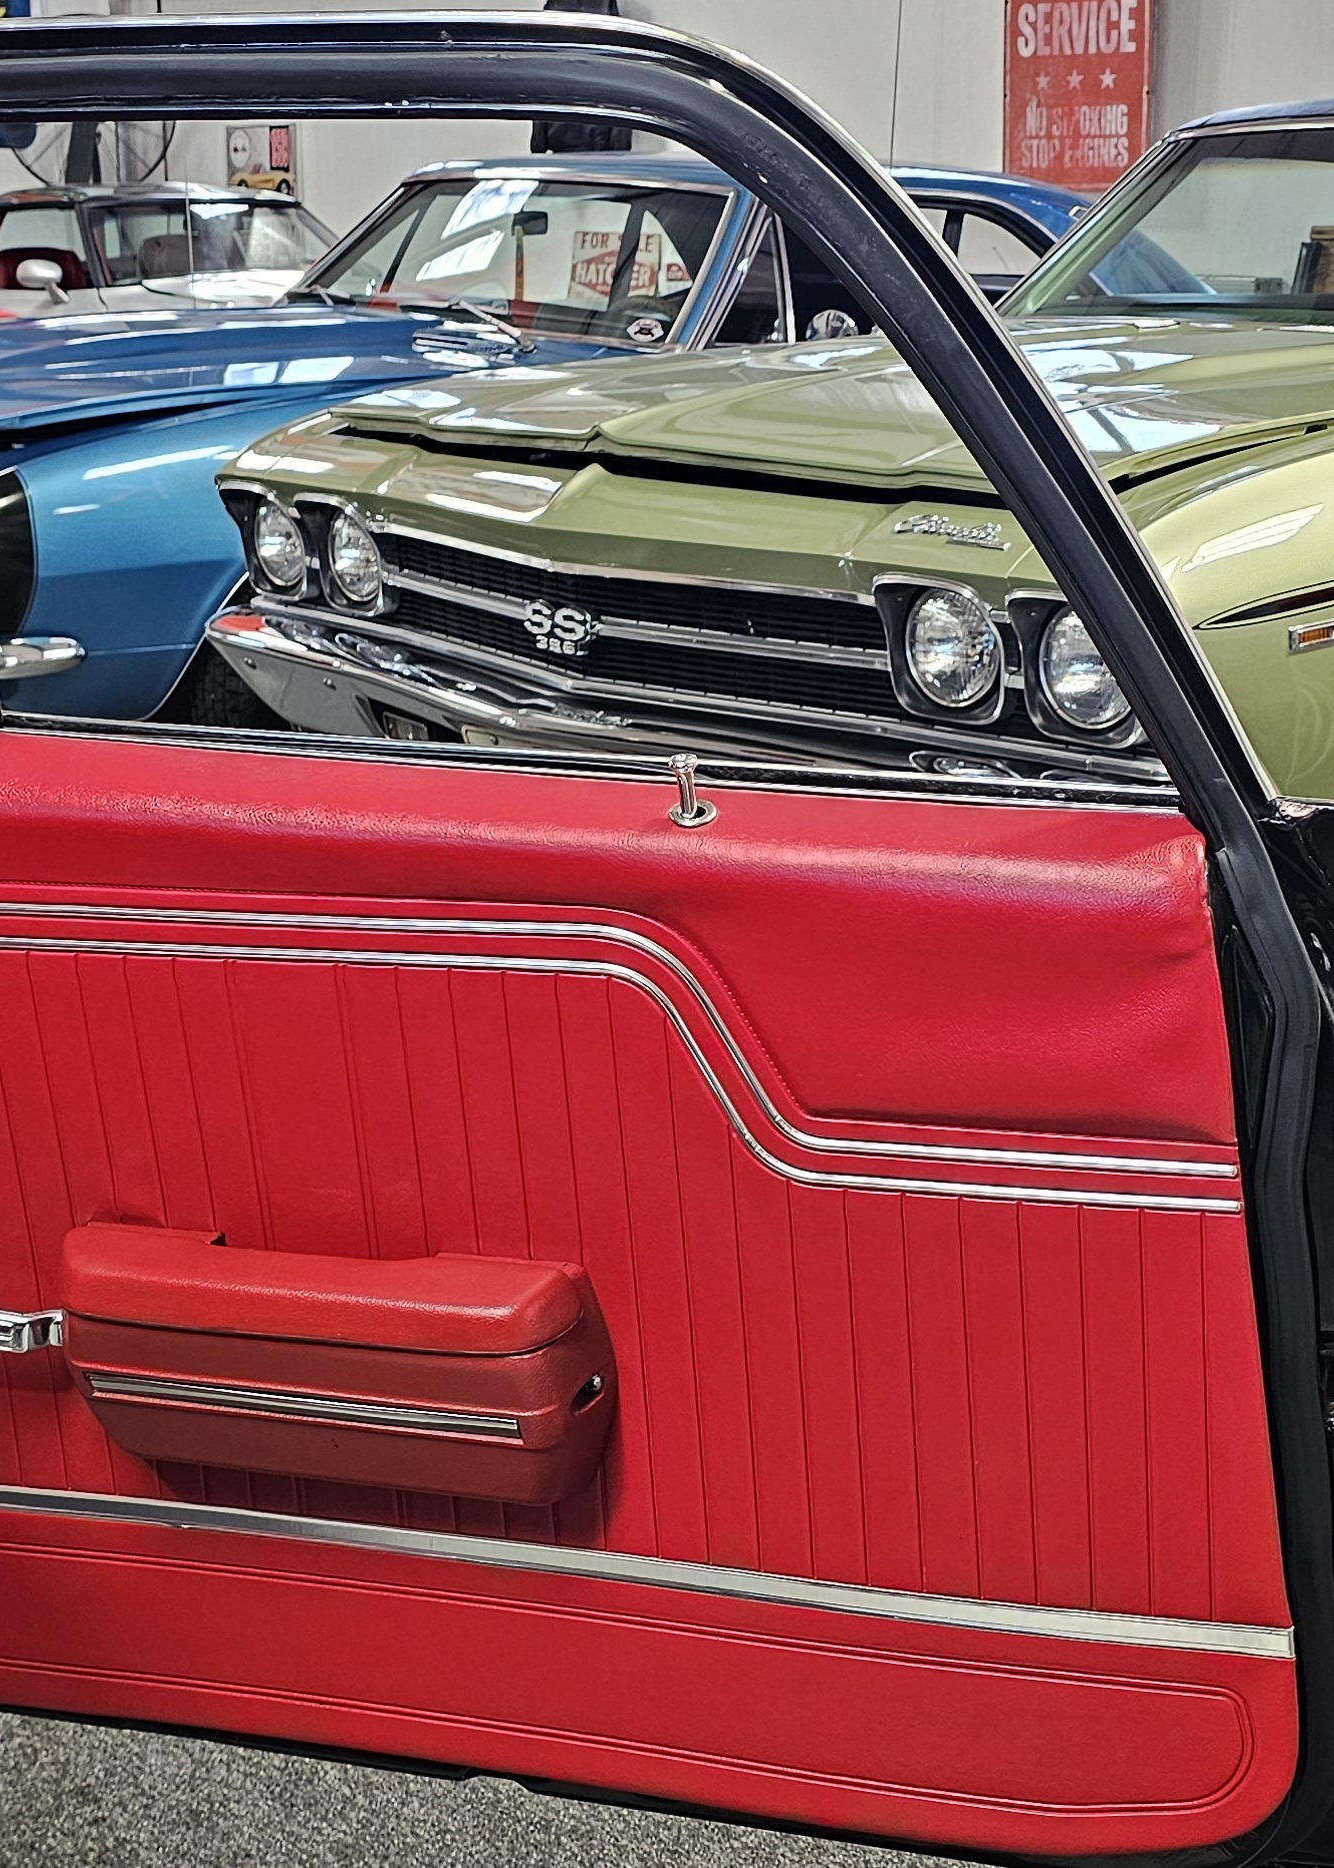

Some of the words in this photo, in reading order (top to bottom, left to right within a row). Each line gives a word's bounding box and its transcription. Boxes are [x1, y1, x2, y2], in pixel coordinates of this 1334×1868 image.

[1017, 0, 1138, 57] SERVICE
[1026, 100, 1047, 137] NO
[1021, 138, 1060, 168] STOP
[1064, 136, 1129, 168] ENGINES
[581, 232, 610, 249] FOR
[575, 261, 652, 288] HATCER
[524, 601, 586, 640] SS
